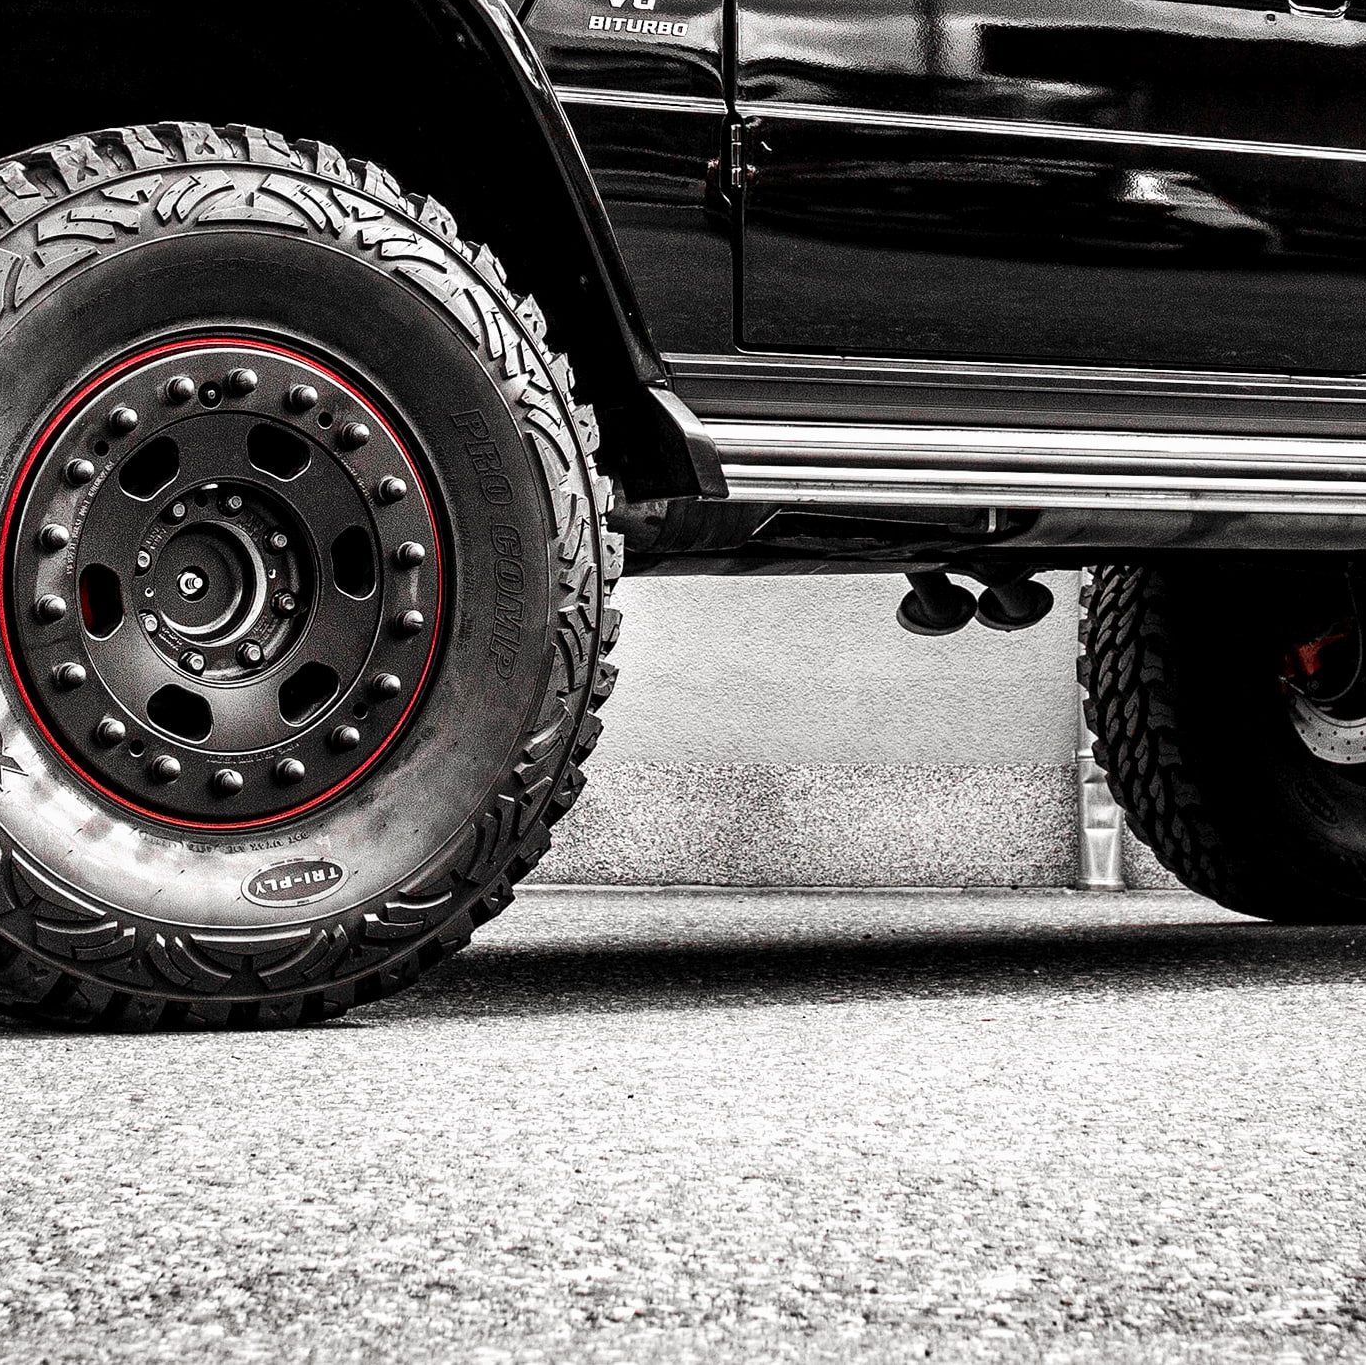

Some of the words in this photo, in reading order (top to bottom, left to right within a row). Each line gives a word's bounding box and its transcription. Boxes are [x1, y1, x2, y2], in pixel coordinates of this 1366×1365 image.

[589, 16, 689, 36] BITURBO
[450, 410, 513, 505] PRO
[490, 524, 525, 680] COMP
[255, 867, 339, 895] TRI-PLY
